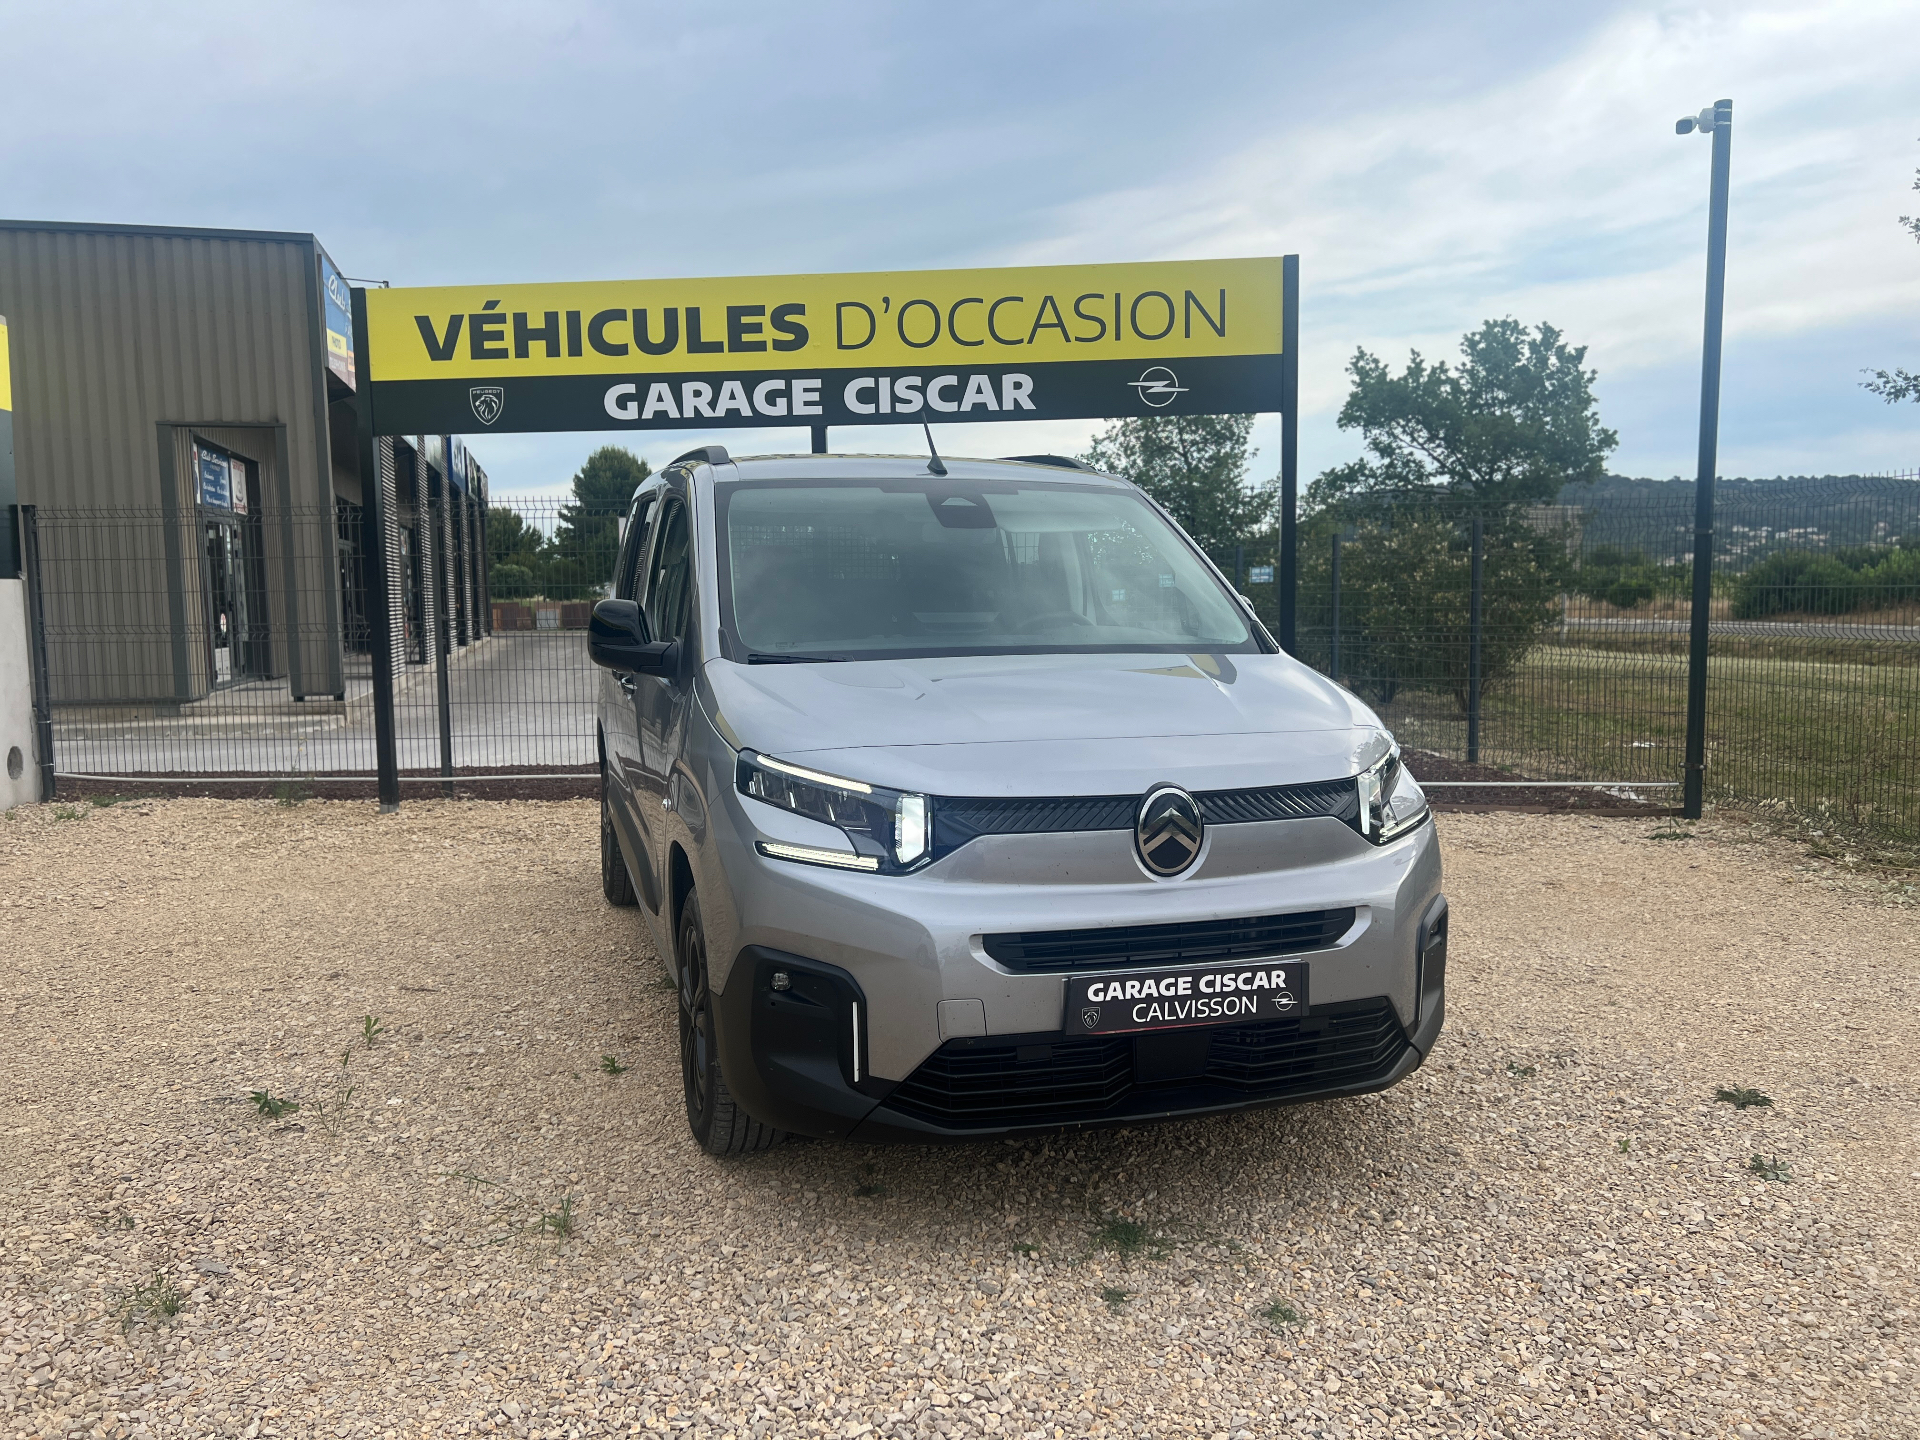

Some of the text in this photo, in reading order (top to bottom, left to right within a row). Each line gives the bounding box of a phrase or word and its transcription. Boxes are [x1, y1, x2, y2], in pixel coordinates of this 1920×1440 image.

[413, 288, 1227, 362] VÉHICULES D'OCCASION
[603, 373, 1037, 420] GARAGE CISCAR
[1087, 969, 1287, 1002] GARAGE CISCAR
[1132, 995, 1258, 1023] CALVISSON
